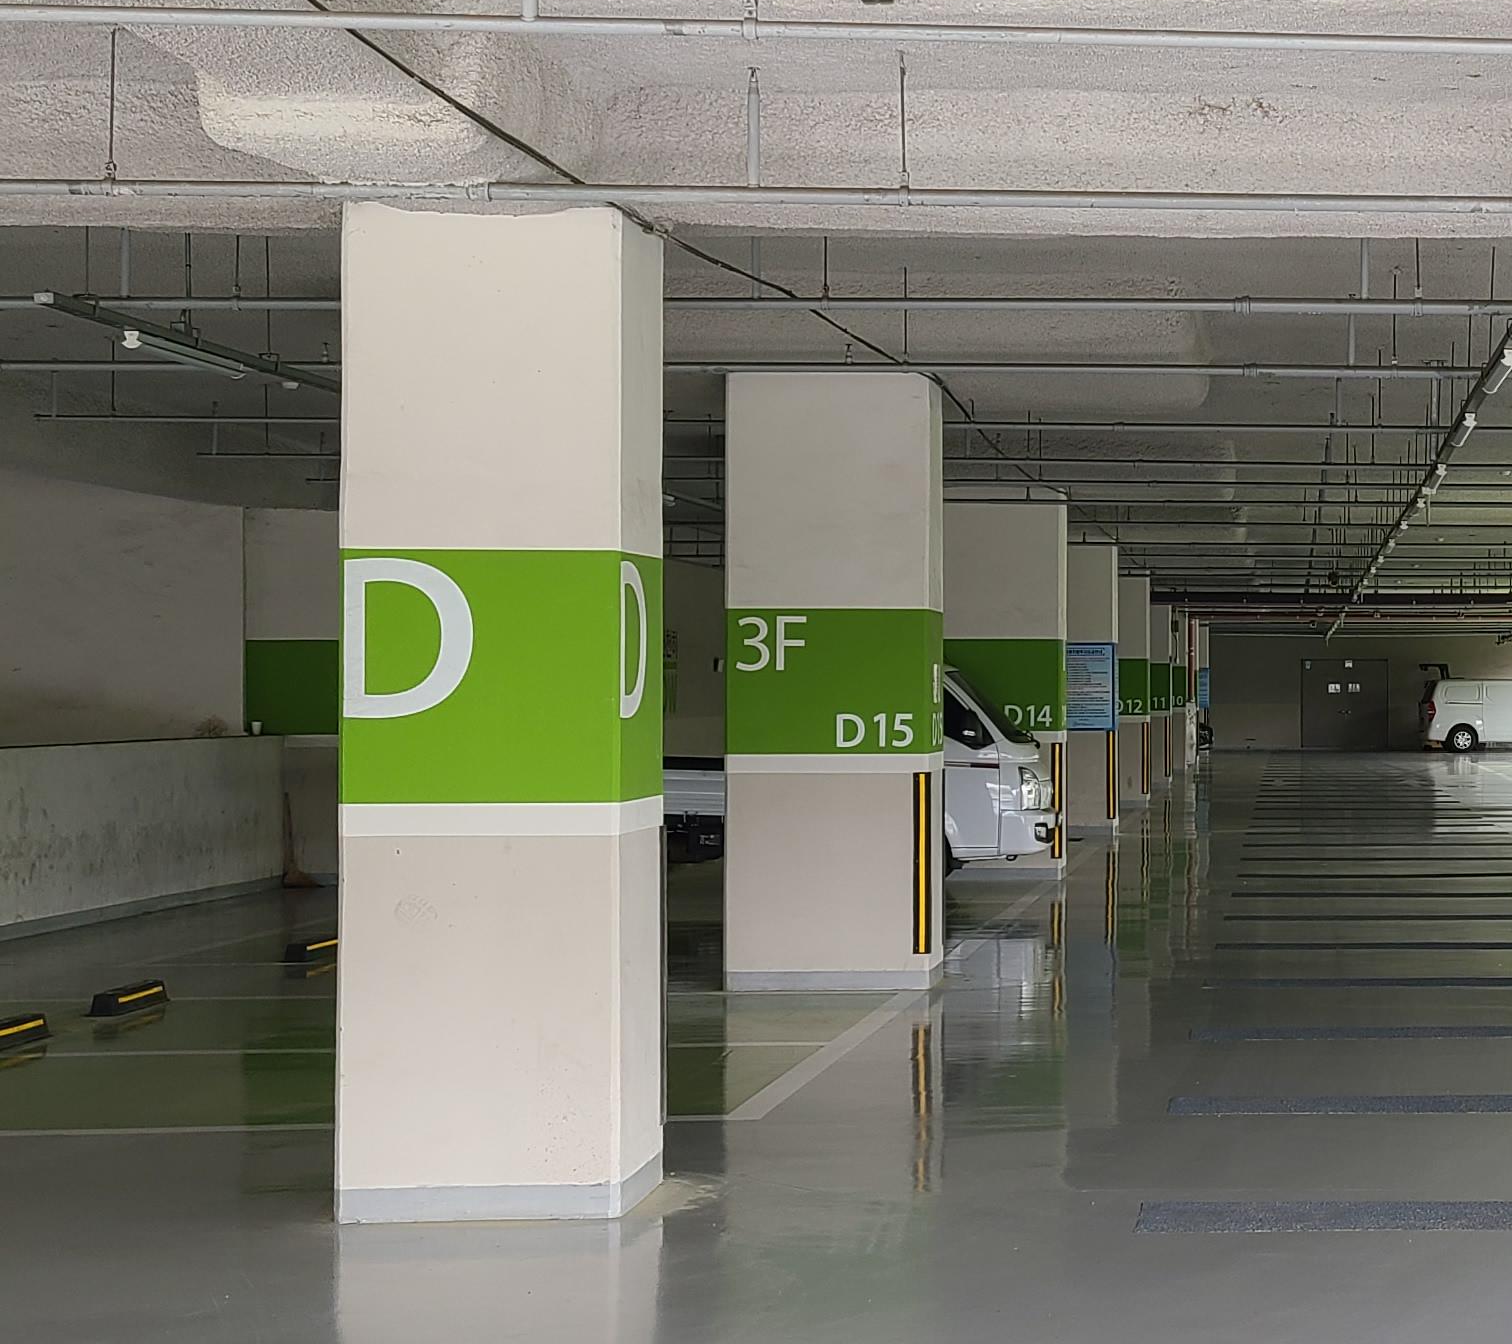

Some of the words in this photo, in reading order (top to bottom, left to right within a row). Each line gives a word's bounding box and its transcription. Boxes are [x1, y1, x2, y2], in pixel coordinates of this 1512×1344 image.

[343, 557, 474, 719] D
[619, 560, 648, 719] D
[735, 615, 808, 672] 3F
[836, 712, 914, 748] D15
